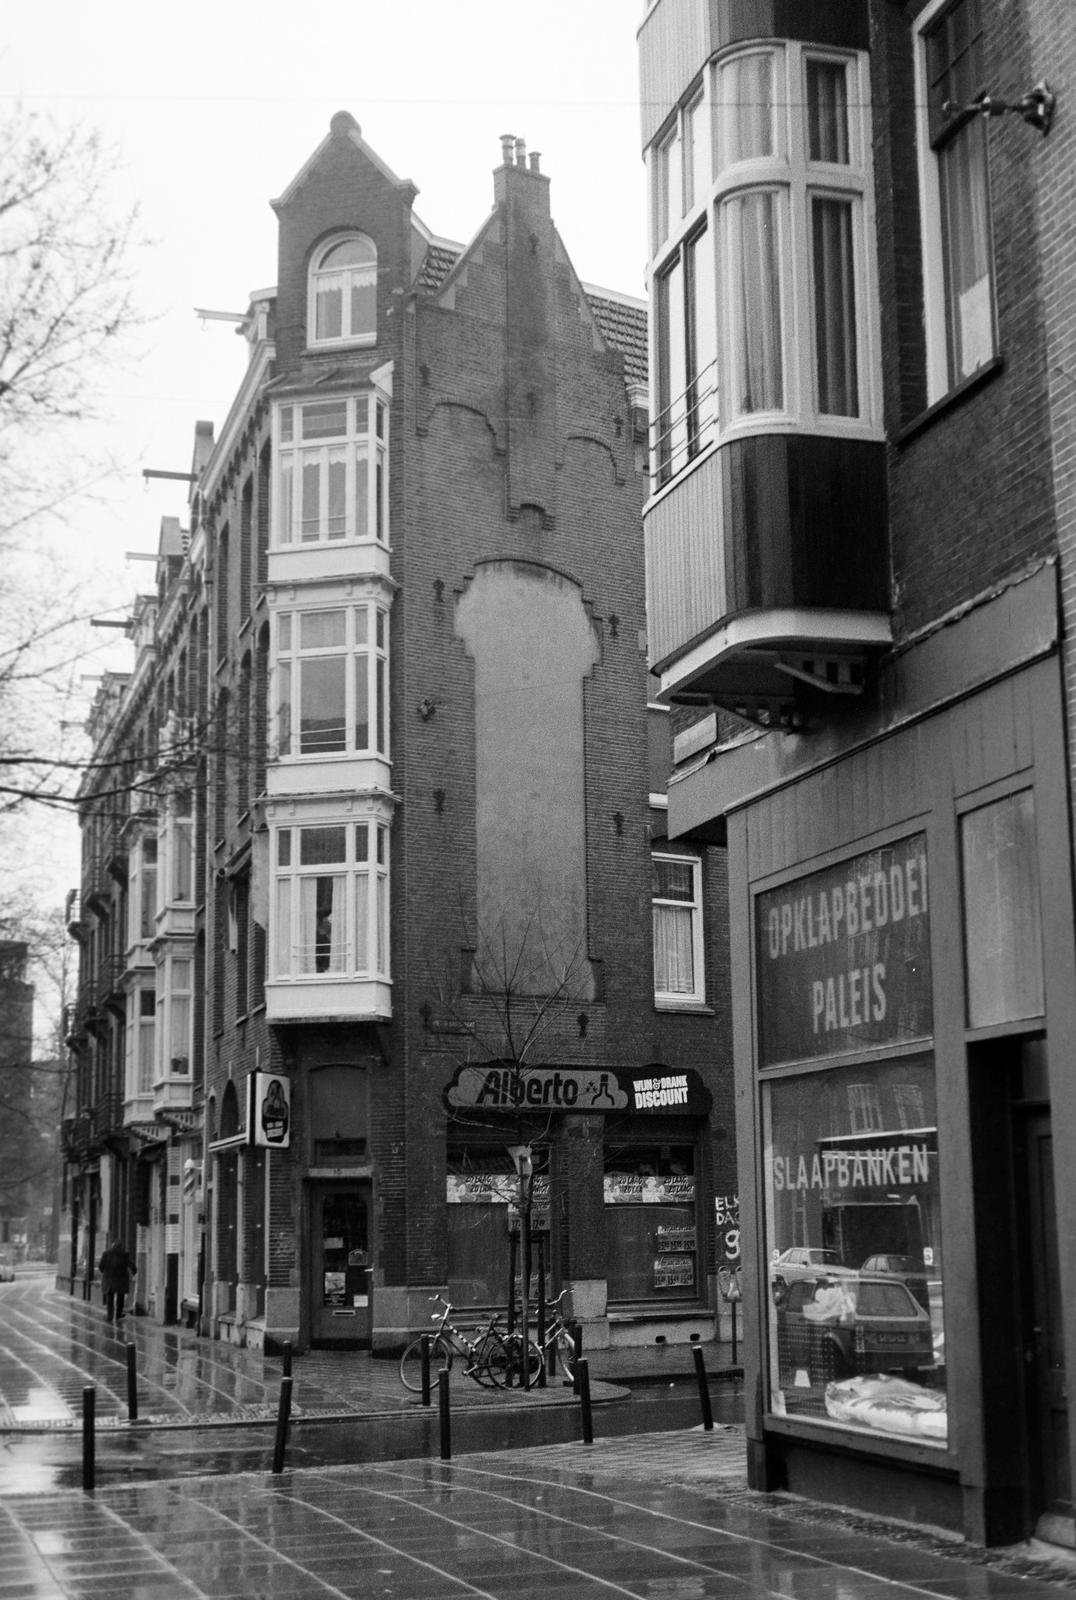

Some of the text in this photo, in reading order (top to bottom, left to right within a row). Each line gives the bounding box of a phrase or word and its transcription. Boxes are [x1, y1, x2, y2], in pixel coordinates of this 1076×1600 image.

[812, 963, 886, 1034] PALEIS
[475, 1070, 579, 1105] Alberto
[635, 1087, 688, 1109] DISCOUNT
[653, 1078, 660, 1090] &
[661, 1075, 688, 1089] DRANK
[774, 1144, 928, 1191] SLAAPBANKEN
